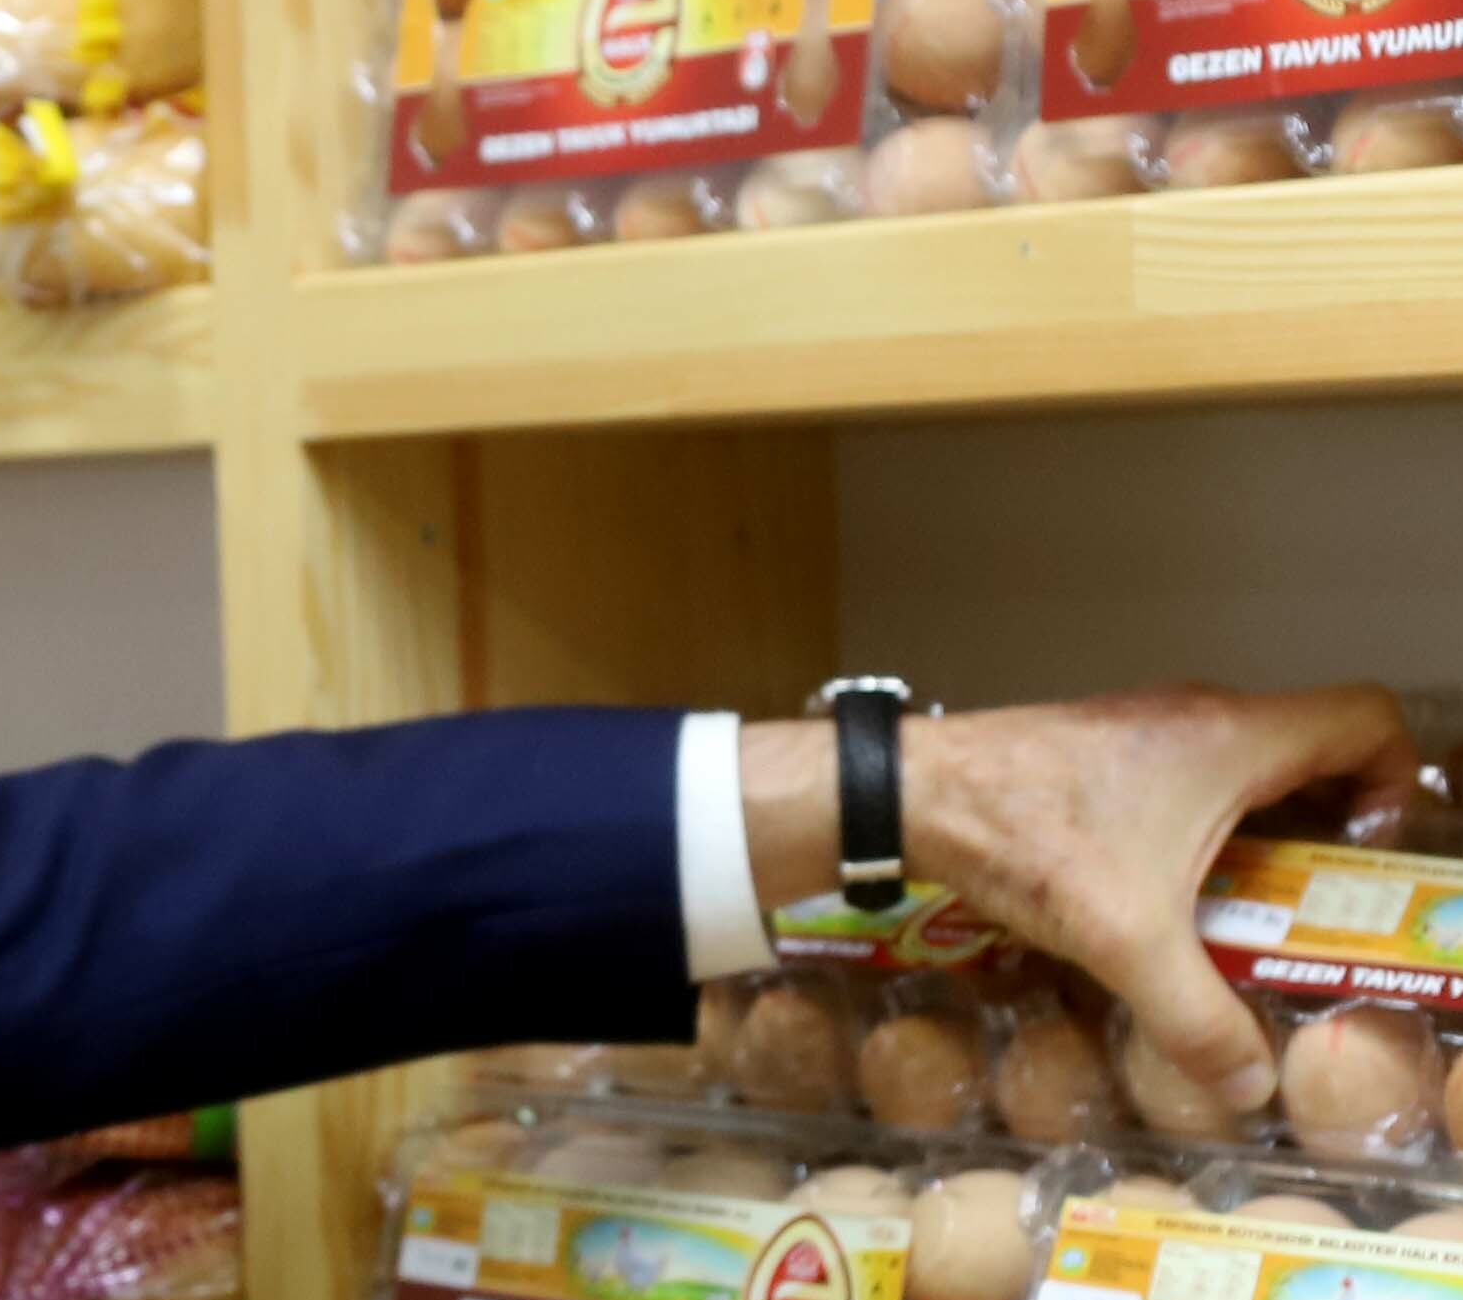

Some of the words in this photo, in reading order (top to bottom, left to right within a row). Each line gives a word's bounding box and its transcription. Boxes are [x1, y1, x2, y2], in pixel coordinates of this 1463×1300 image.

[1168, 44, 1261, 82] GEZEN
[1270, 34, 1361, 69] TAVUK
[1253, 957, 1343, 984] GEZEN
[1351, 965, 1444, 997] TAVUK
